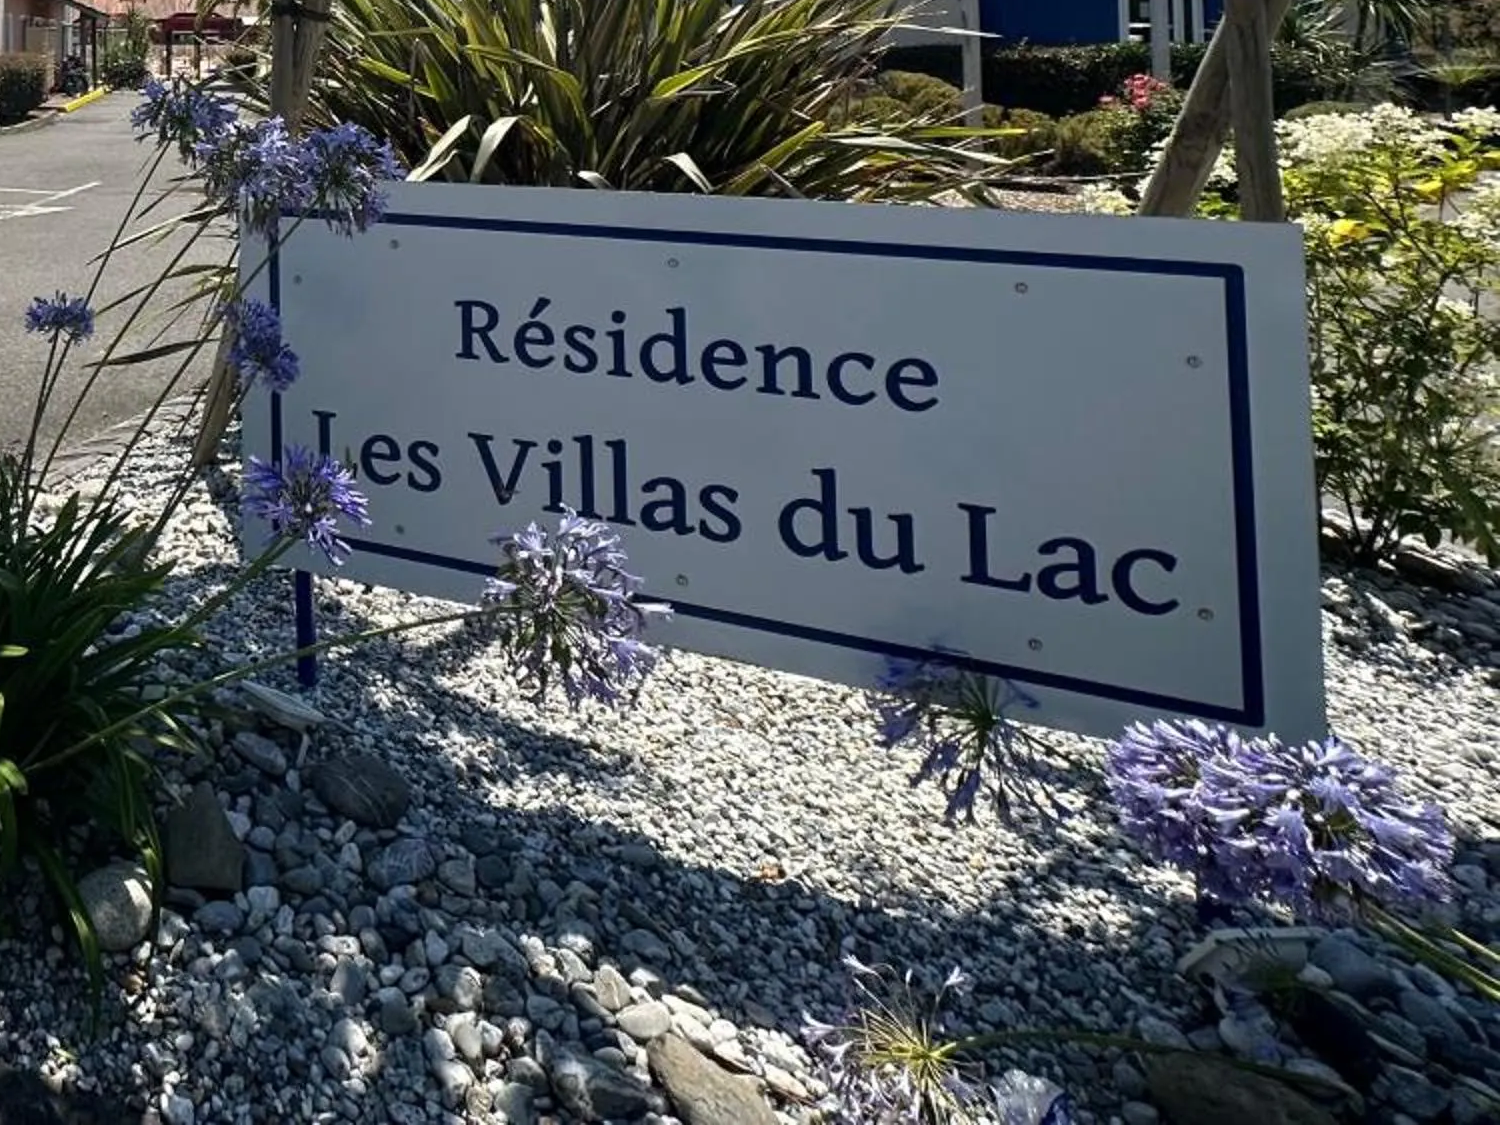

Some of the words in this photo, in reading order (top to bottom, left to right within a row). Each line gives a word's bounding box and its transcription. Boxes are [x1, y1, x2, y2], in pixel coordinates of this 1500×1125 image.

[454, 297, 940, 412] Résidence
[467, 432, 743, 543] Villas
[778, 467, 925, 574] du
[957, 502, 1178, 617] Lac
